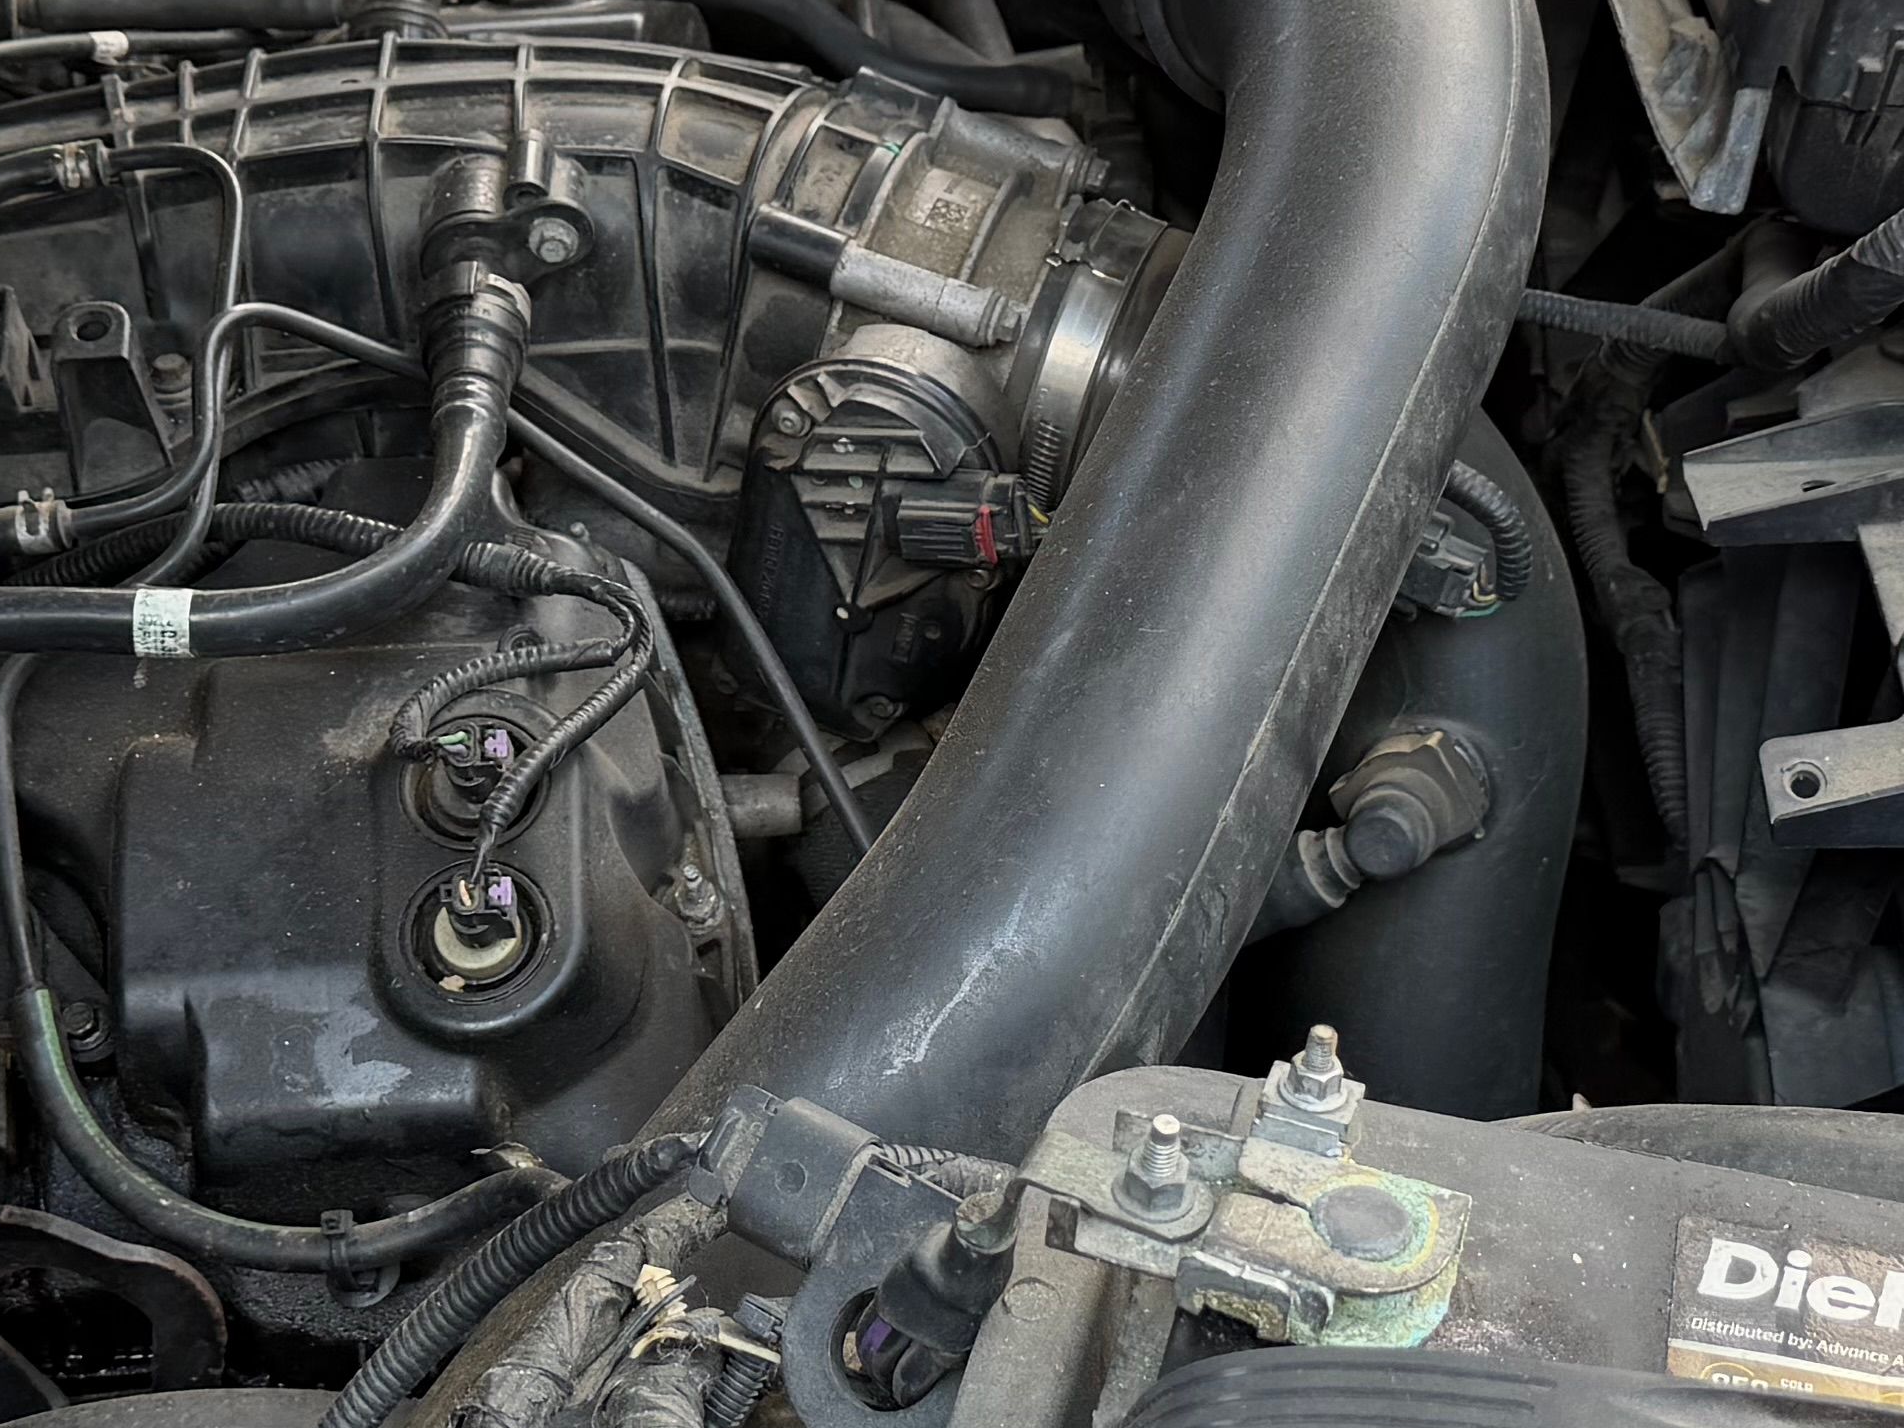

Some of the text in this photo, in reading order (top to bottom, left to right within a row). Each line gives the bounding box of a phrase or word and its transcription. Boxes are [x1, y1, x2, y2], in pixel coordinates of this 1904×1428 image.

[1691, 1317, 1784, 1344] Distributed
[1788, 1332, 1814, 1350] by:
[1816, 1339, 1889, 1364] Advance
